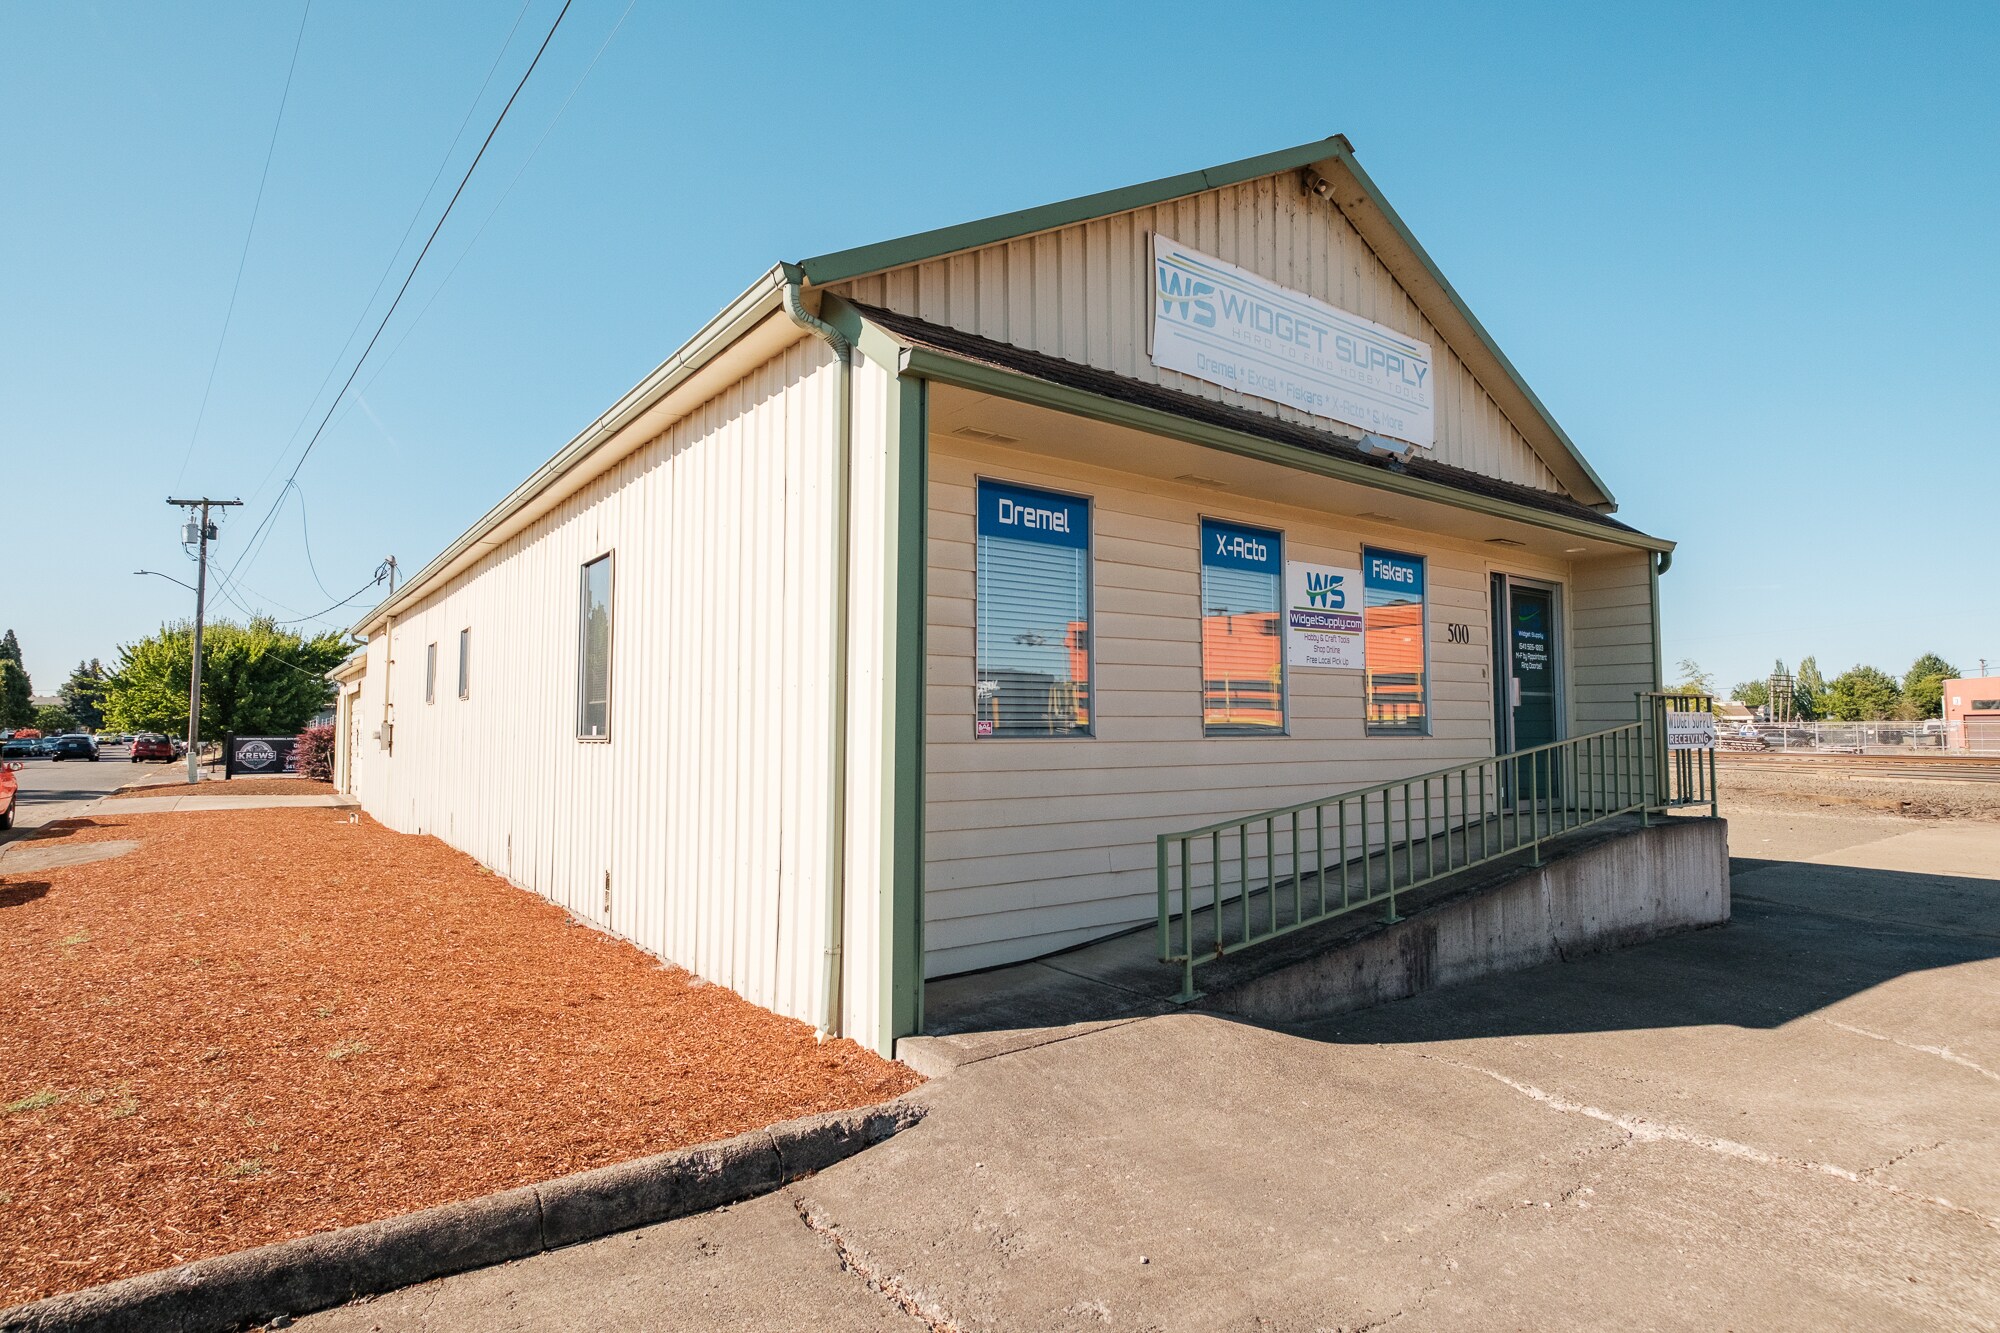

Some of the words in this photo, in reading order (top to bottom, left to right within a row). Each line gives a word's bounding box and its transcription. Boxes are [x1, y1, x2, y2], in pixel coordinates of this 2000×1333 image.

[1159, 267, 1216, 328] WS
[1219, 289, 1329, 353] WIDGET
[1335, 335, 1428, 389] SUPPLY
[1232, 326, 1272, 350] HARD
[1280, 344, 1296, 358] TO
[1304, 352, 1333, 370] FIND
[1340, 367, 1381, 385] HOBBY
[1386, 381, 1425, 402] TOOLS
[1197, 352, 1237, 380] Dremel
[1247, 368, 1277, 392] Excel
[1286, 383, 1323, 407] Fiskars
[1332, 396, 1365, 419] X-Acto
[1382, 411, 1404, 431] More
[998, 498, 1070, 533] Dremel
[1216, 533, 1267, 562] X-Acto
[1372, 559, 1414, 584] Fiskars
[1306, 571, 1346, 609] WS
[1290, 613, 1362, 630] WidgetSupply.com
[1304, 633, 1319, 643] Hobby
[1325, 634, 1337, 643] Craft
[1338, 636, 1350, 644] Tools
[1447, 623, 1469, 644] 500
[1306, 656, 1318, 664] Free
[1318, 656, 1331, 665] Local
[1332, 656, 1343, 665] Pick
[1313, 644, 1325, 654] Shop
[1326, 645, 1340, 654] Online
[1668, 713, 1691, 729] WIDGET
[1692, 713, 1713, 729] SUPPLY
[1669, 734, 1709, 744] RECEIVING
[238, 752, 274, 760] KREWS
